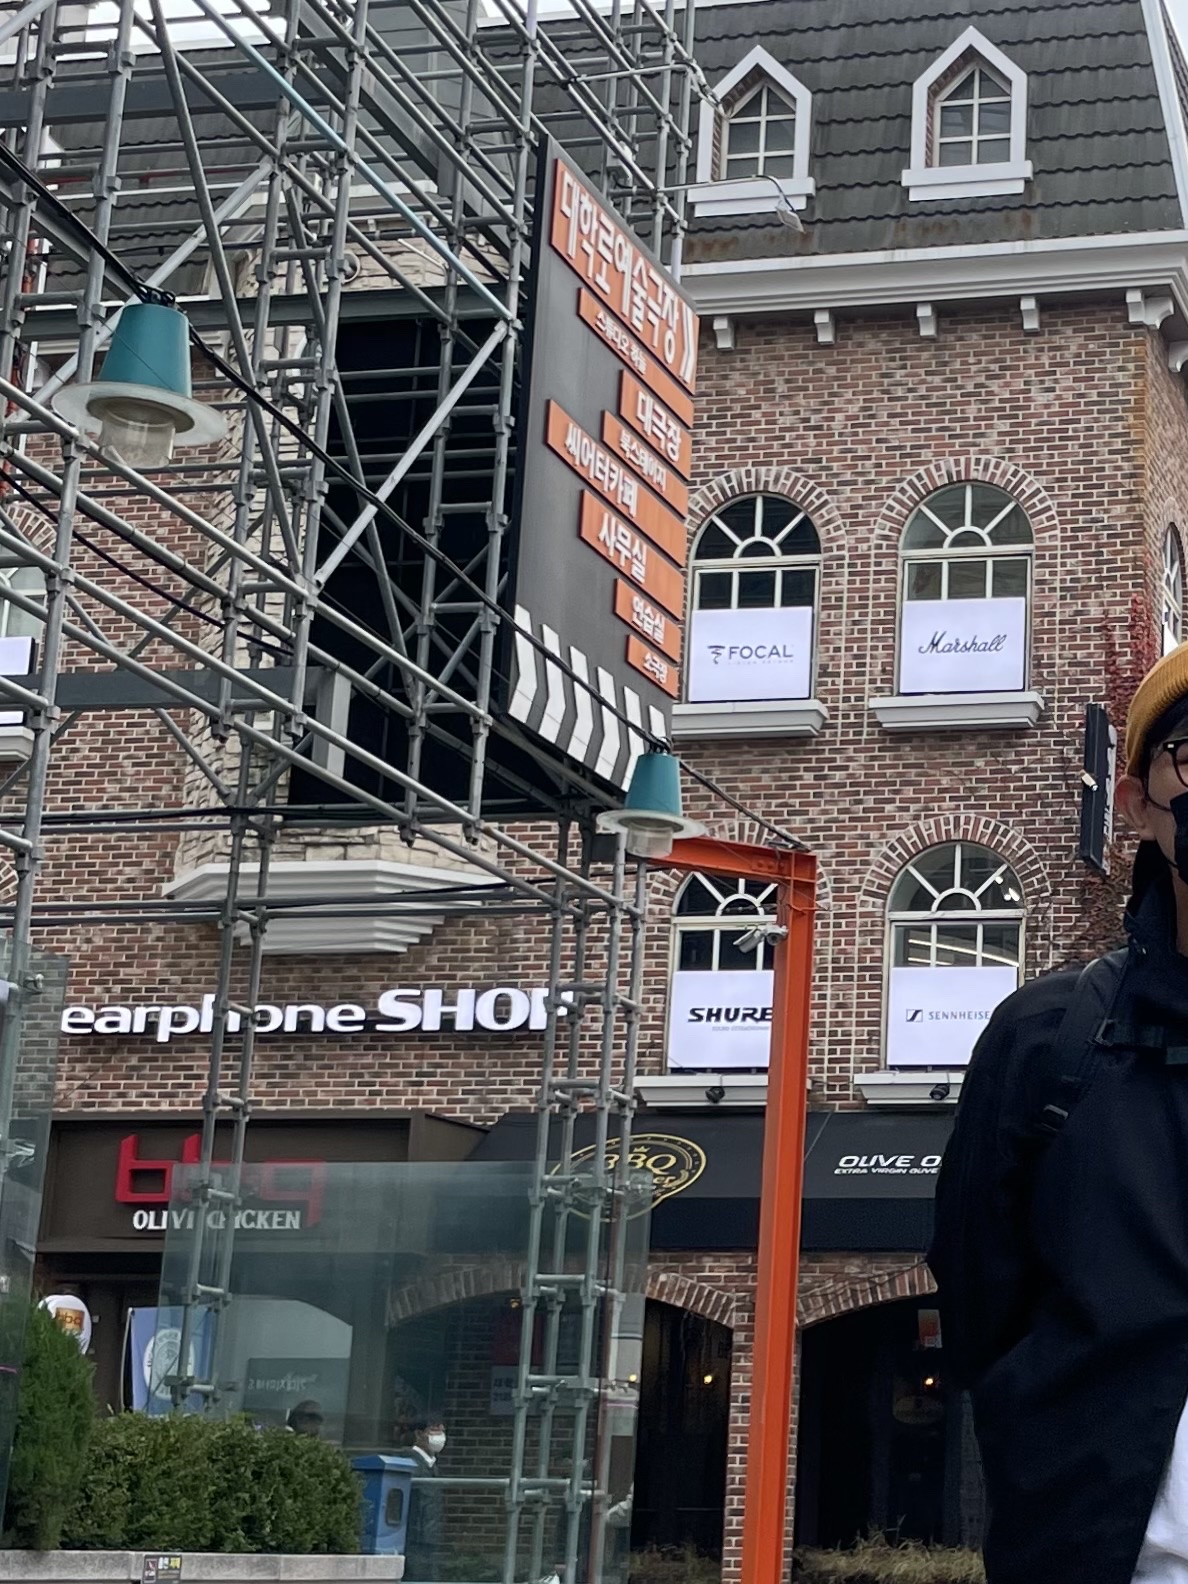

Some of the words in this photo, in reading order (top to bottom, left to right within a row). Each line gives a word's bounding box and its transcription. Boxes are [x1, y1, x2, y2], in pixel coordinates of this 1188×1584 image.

[560, 169, 680, 364] 대학로예술극장
[636, 390, 682, 462] 대극장
[565, 422, 638, 518] 씨어터카페
[619, 428, 667, 493] 북스테이지
[598, 512, 647, 584] 사무실
[632, 595, 665, 645] 연습실
[918, 630, 1007, 655] Marshall
[728, 644, 794, 660] FOCAL
[59, 993, 367, 1044] earphone
[687, 1006, 774, 1023] SHURE
[928, 1010, 991, 1021] SENNHEISE
[833, 1167, 868, 1175] EXTRA
[871, 1167, 908, 1175] VIRGIN
[838, 1154, 915, 1168] OLIVE
[920, 1155, 943, 1168] O
